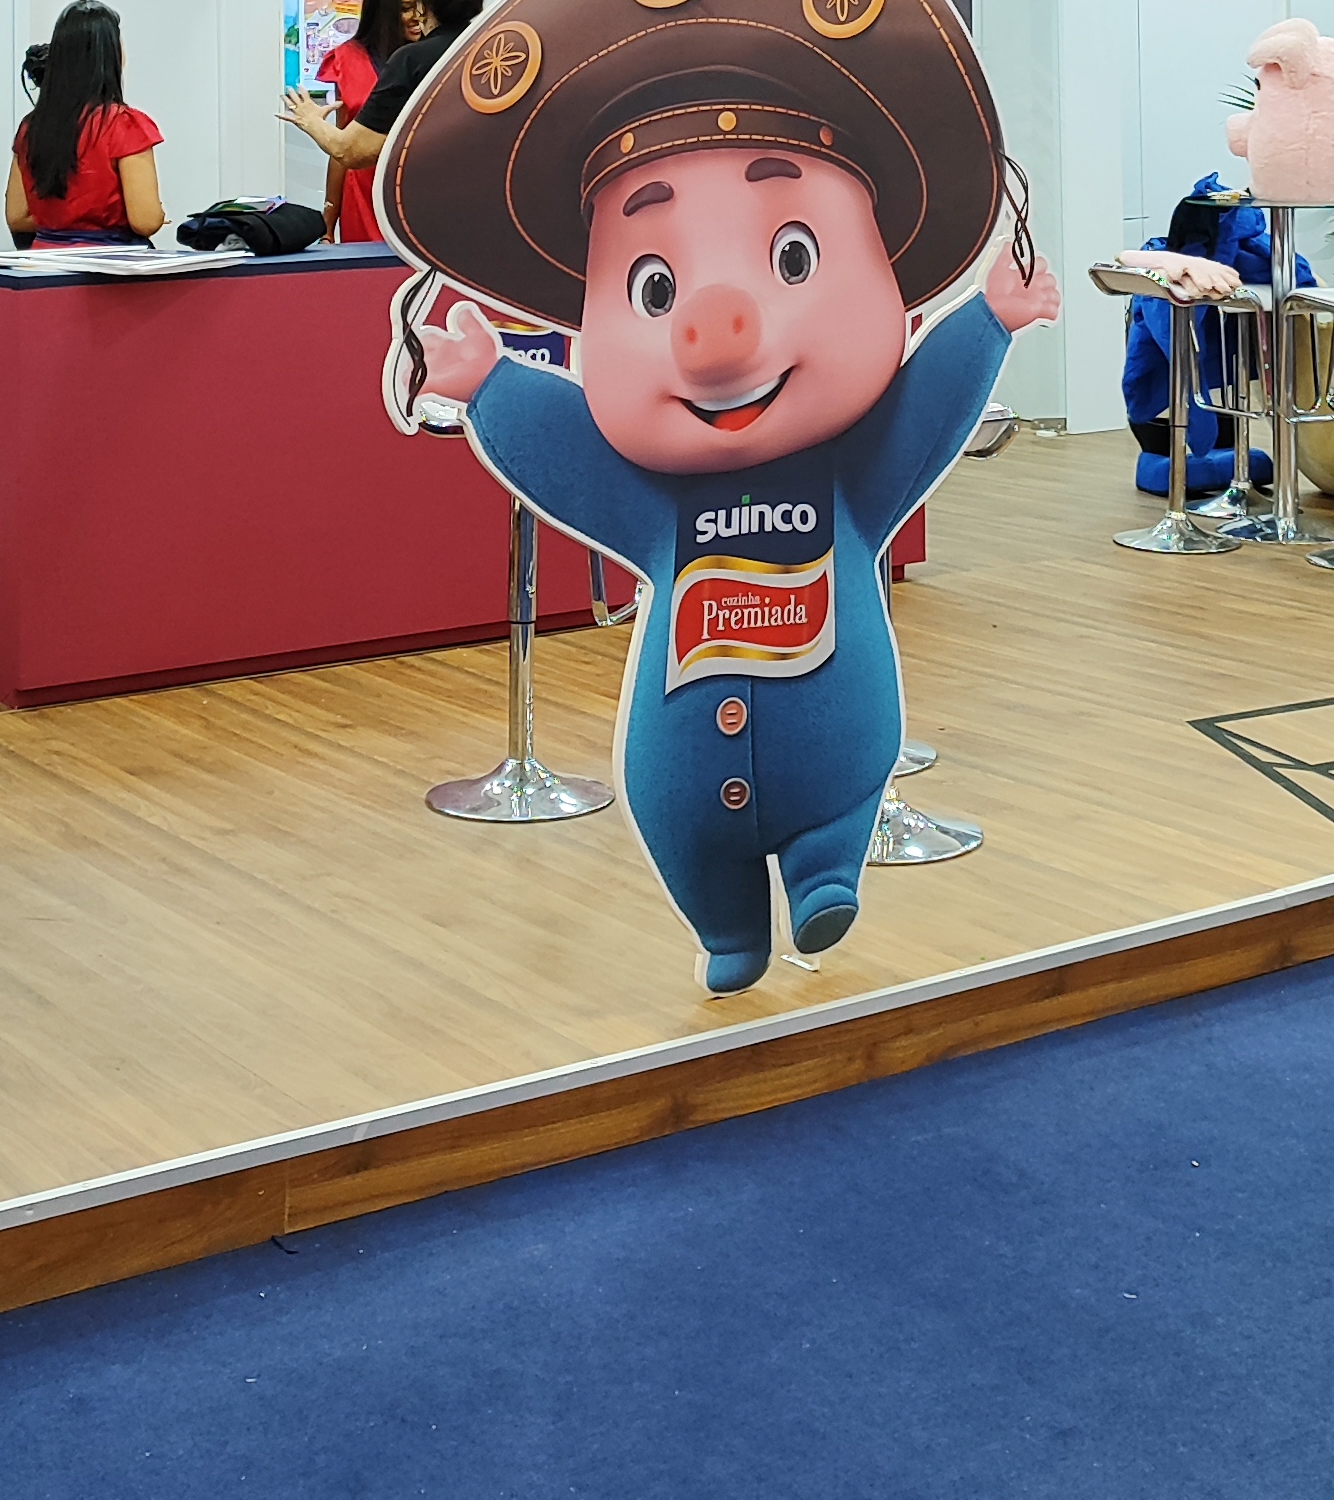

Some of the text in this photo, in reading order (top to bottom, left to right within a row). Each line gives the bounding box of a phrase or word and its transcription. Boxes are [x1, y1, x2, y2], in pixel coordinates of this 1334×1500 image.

[696, 494, 817, 543] suinco
[701, 594, 808, 640] Premiada
[721, 592, 761, 606] cozinha
